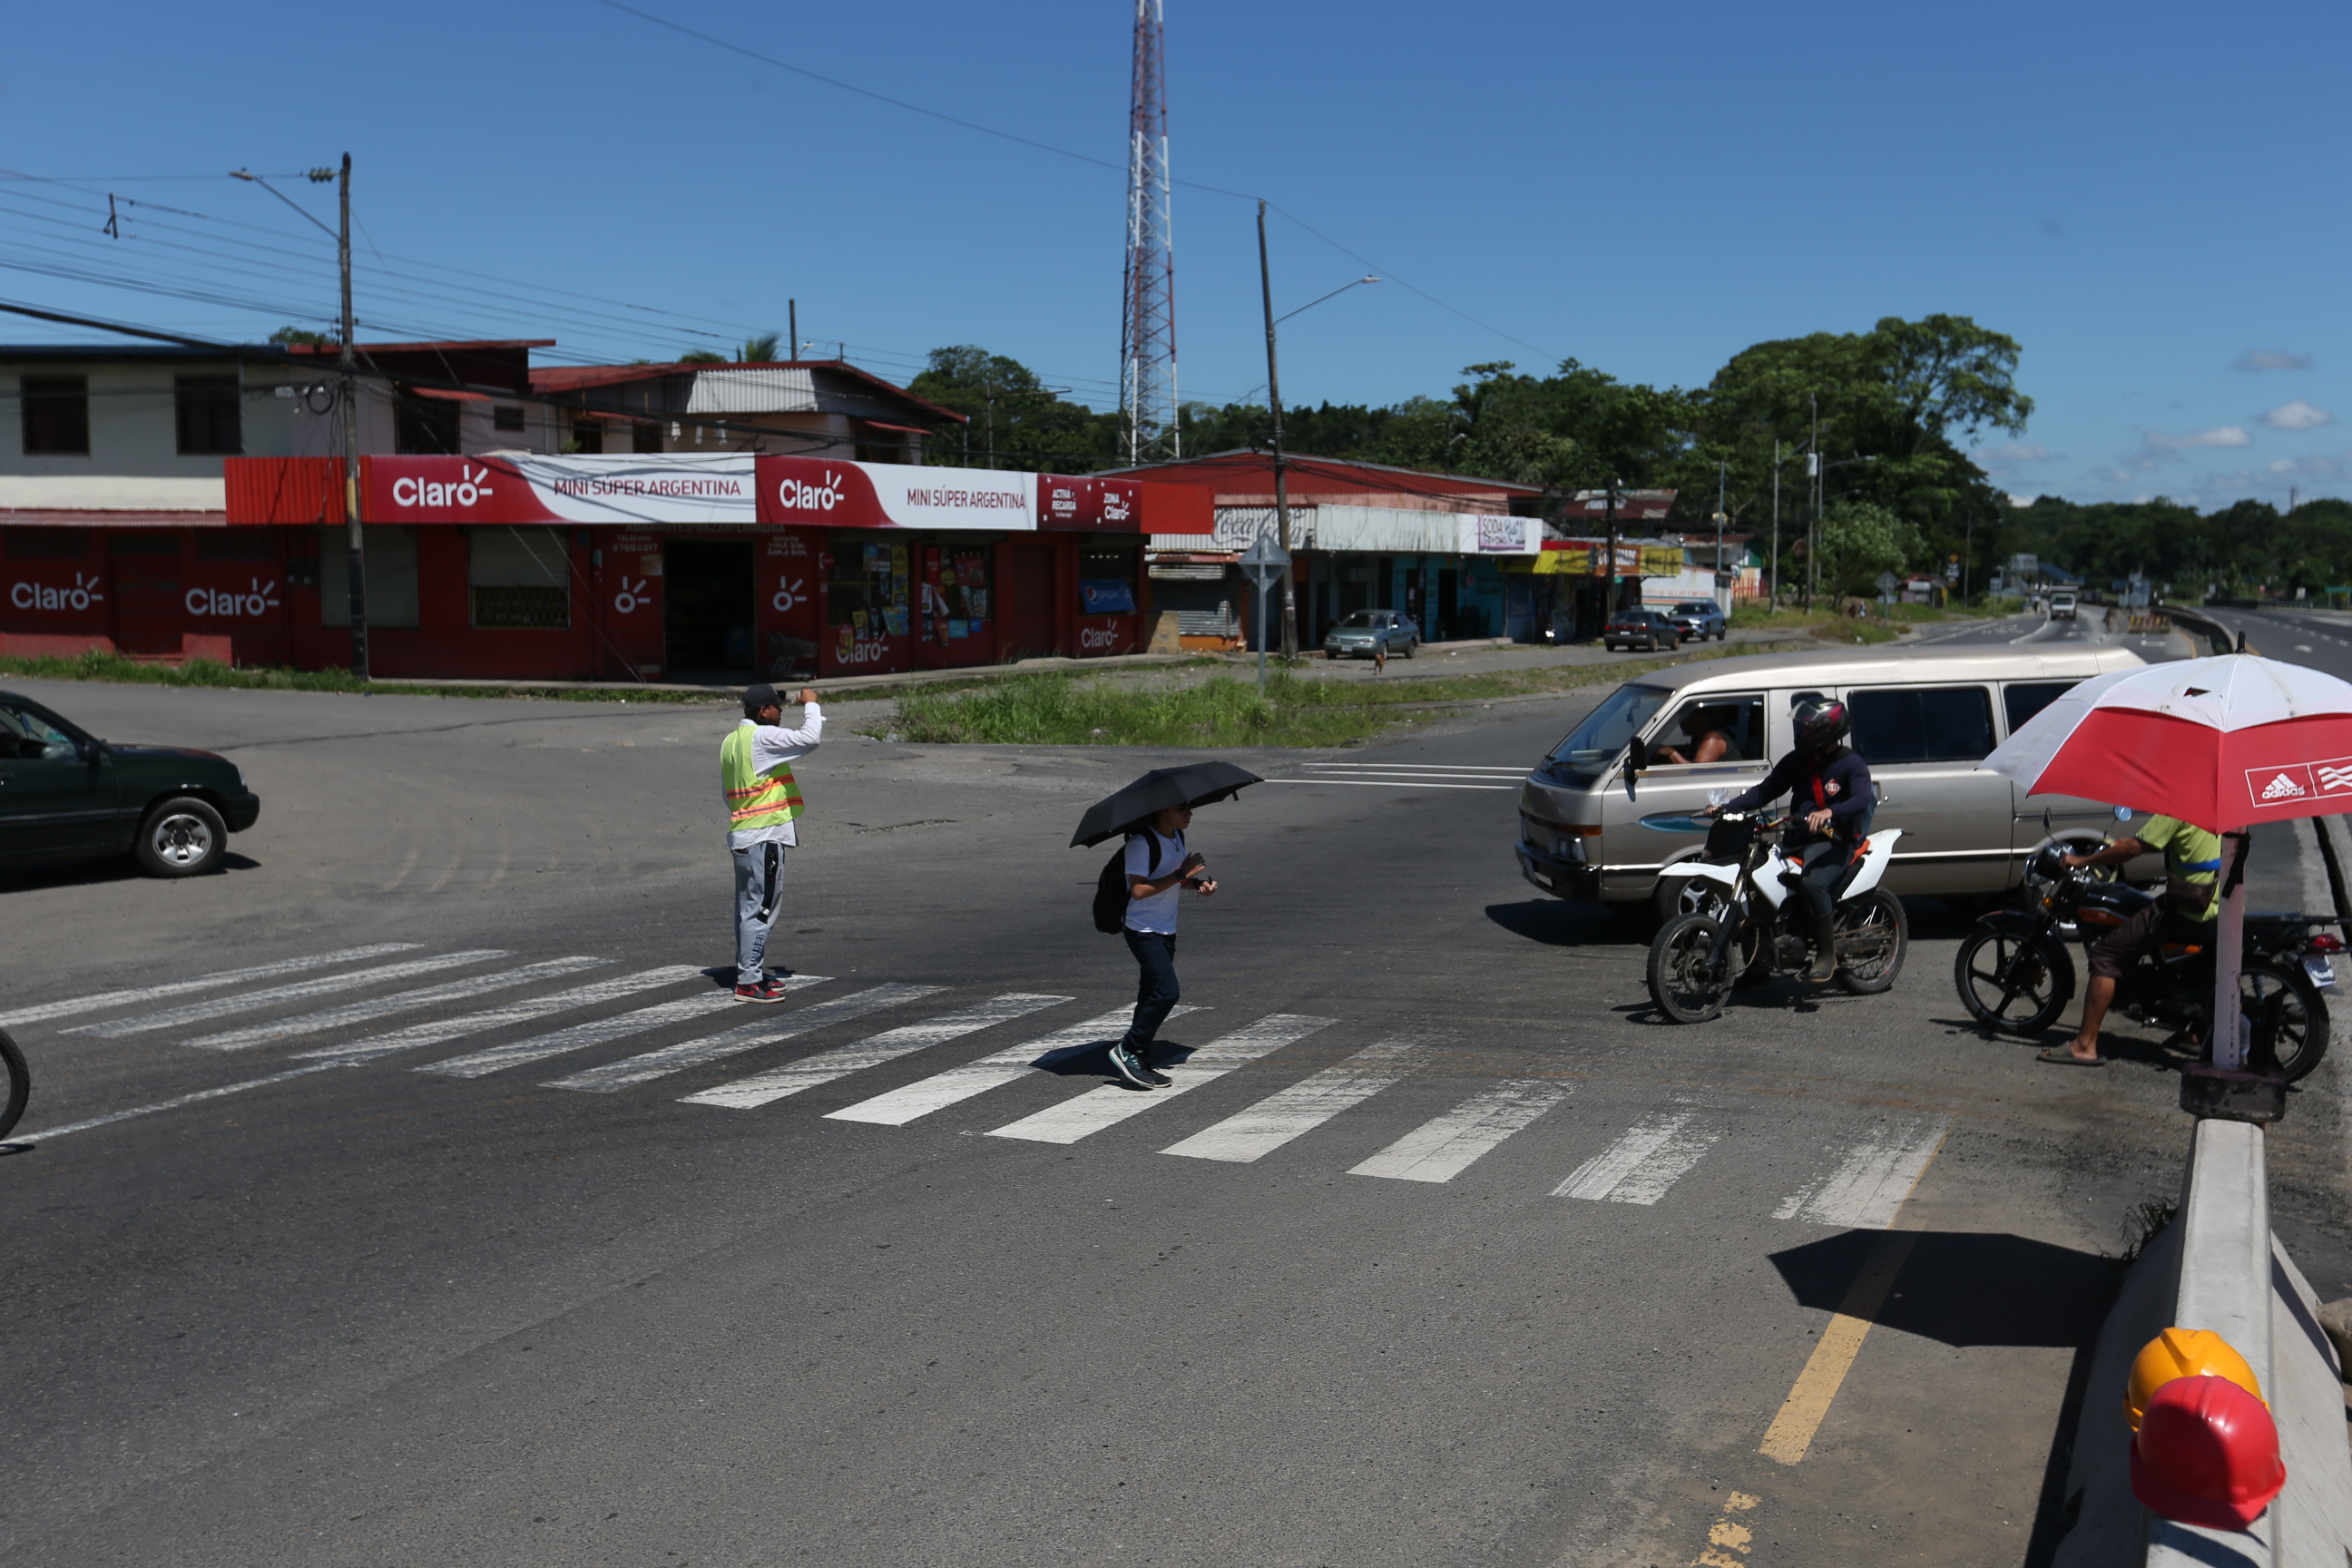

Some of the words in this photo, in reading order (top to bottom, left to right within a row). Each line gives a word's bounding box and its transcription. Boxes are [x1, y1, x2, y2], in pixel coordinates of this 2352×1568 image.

[392, 475, 479, 507] Claro
[554, 479, 589, 495] MINI
[592, 475, 645, 496] SÚPER
[648, 479, 741, 496] ARGENTINA
[779, 477, 836, 511] Claro
[906, 487, 932, 507] MINI
[933, 484, 968, 508] SÚPER
[969, 490, 1026, 510] ARGENTINA
[1104, 505, 1127, 521] Claro
[1483, 518, 1504, 534] SODA
[11, 582, 90, 611] Claro
[185, 587, 266, 616] Claro
[1081, 628, 1113, 648] Claro
[2261, 784, 2306, 799] adidas
